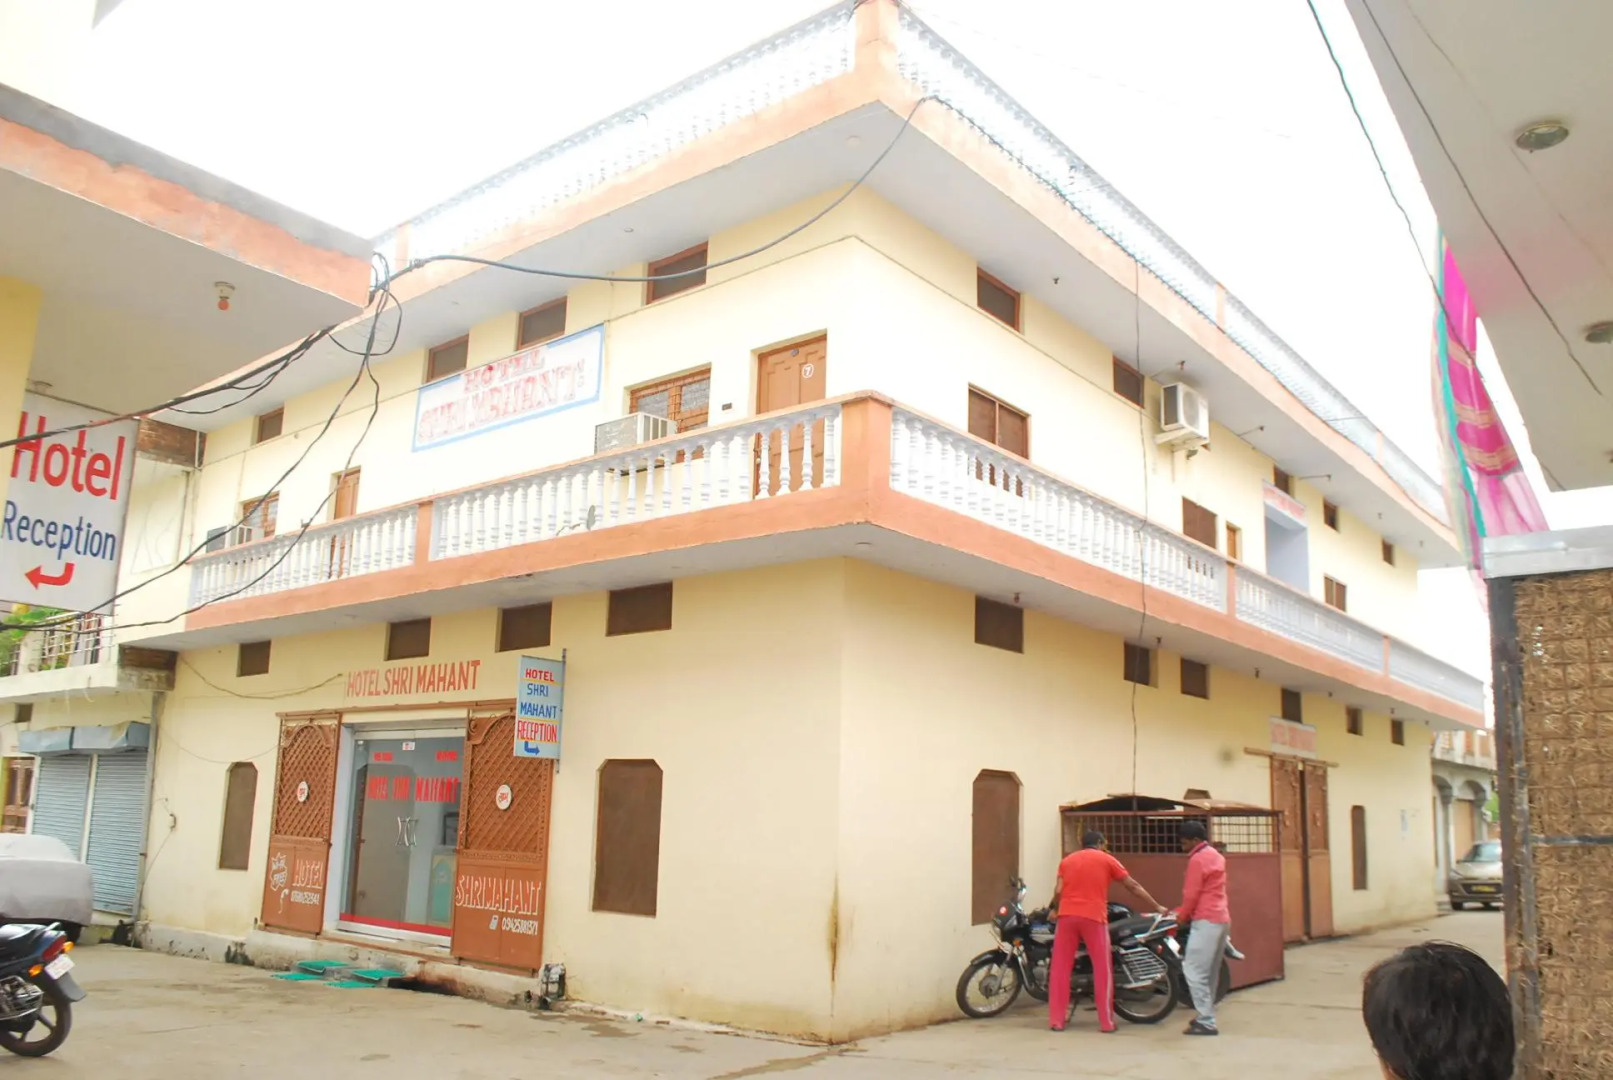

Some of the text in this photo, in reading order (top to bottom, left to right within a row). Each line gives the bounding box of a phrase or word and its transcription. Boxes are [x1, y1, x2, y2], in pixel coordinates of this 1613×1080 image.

[10, 411, 125, 500] Hotel
[1, 500, 116, 560] Reception
[347, 660, 481, 698] HOTEL SHRI MAHANT
[525, 668, 555, 682] HOTEL
[527, 683, 549, 697] SHRI
[520, 702, 558, 719] MAHANT
[517, 720, 558, 742] RECEPTION
